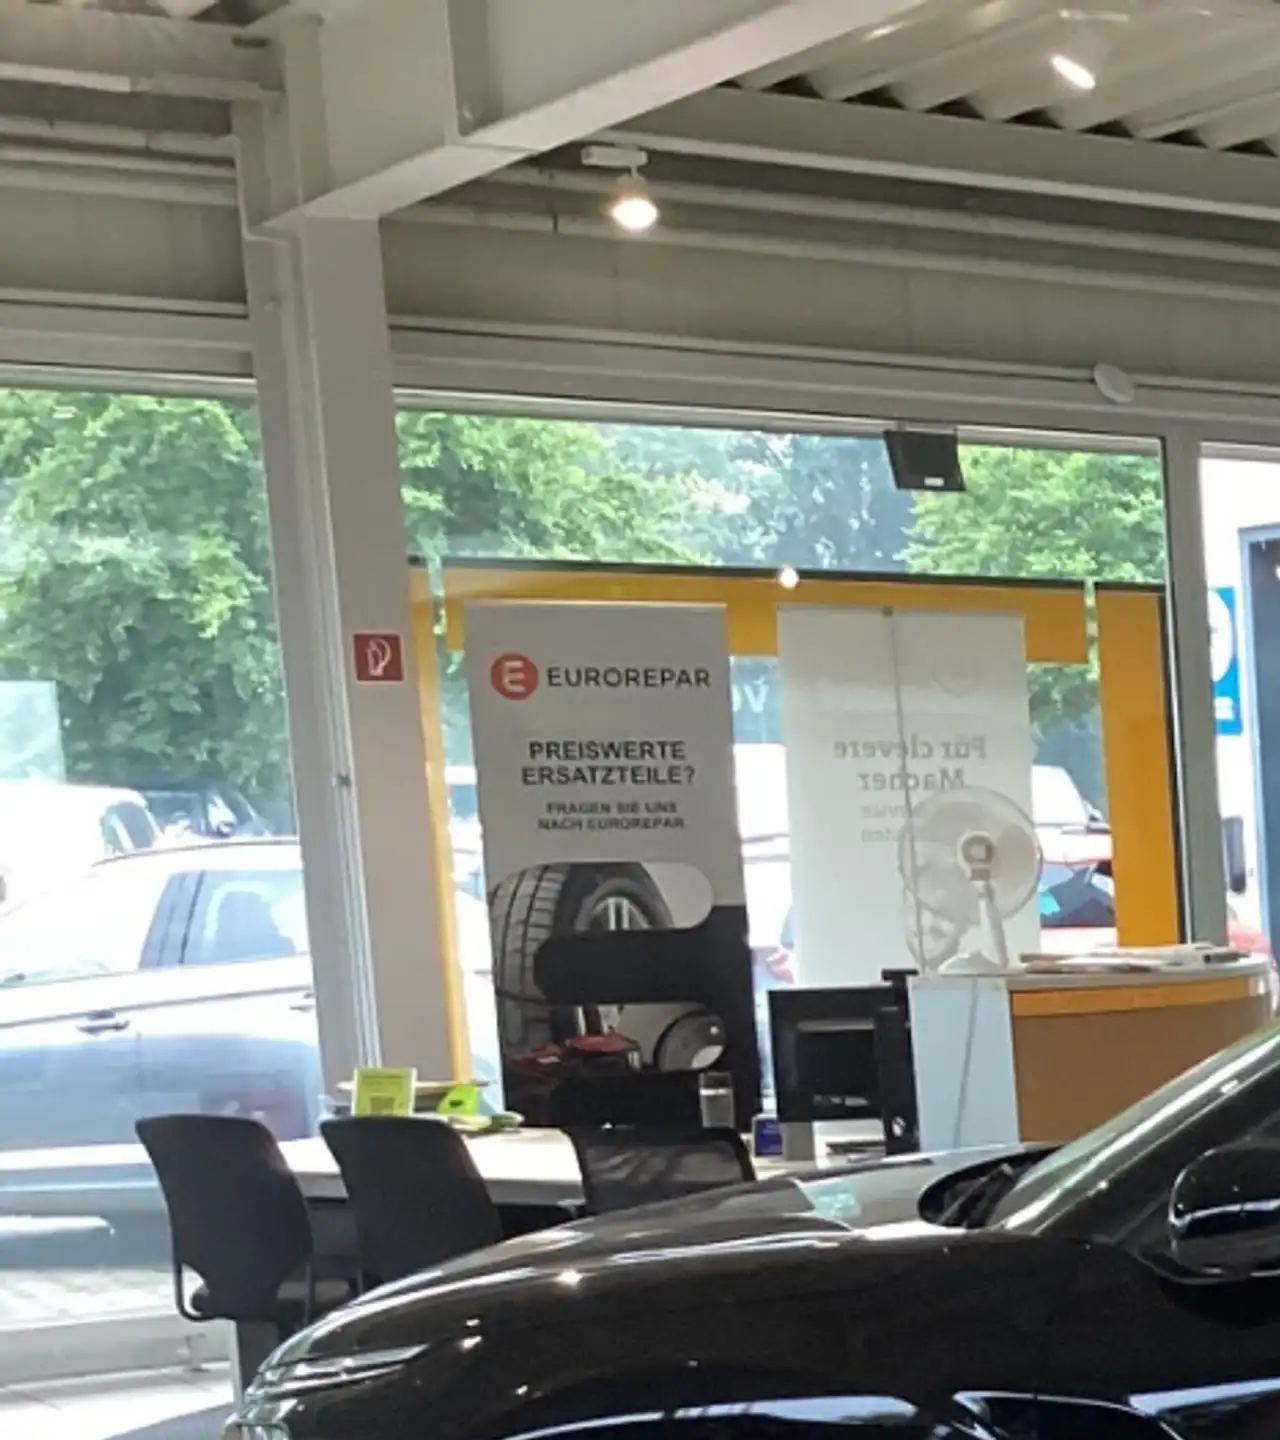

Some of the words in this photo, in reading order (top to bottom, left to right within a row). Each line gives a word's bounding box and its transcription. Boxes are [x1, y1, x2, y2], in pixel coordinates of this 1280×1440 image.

[547, 666, 711, 689] EUROREPAR
[529, 740, 687, 761] PREISWERTE
[521, 765, 696, 786] ERSATZTEILE?
[546, 801, 611, 814] FRAGEN
[616, 801, 641, 814] SIE
[645, 801, 678, 814] UNS
[538, 817, 583, 831] NACH
[586, 817, 685, 830] EUROREPAR
